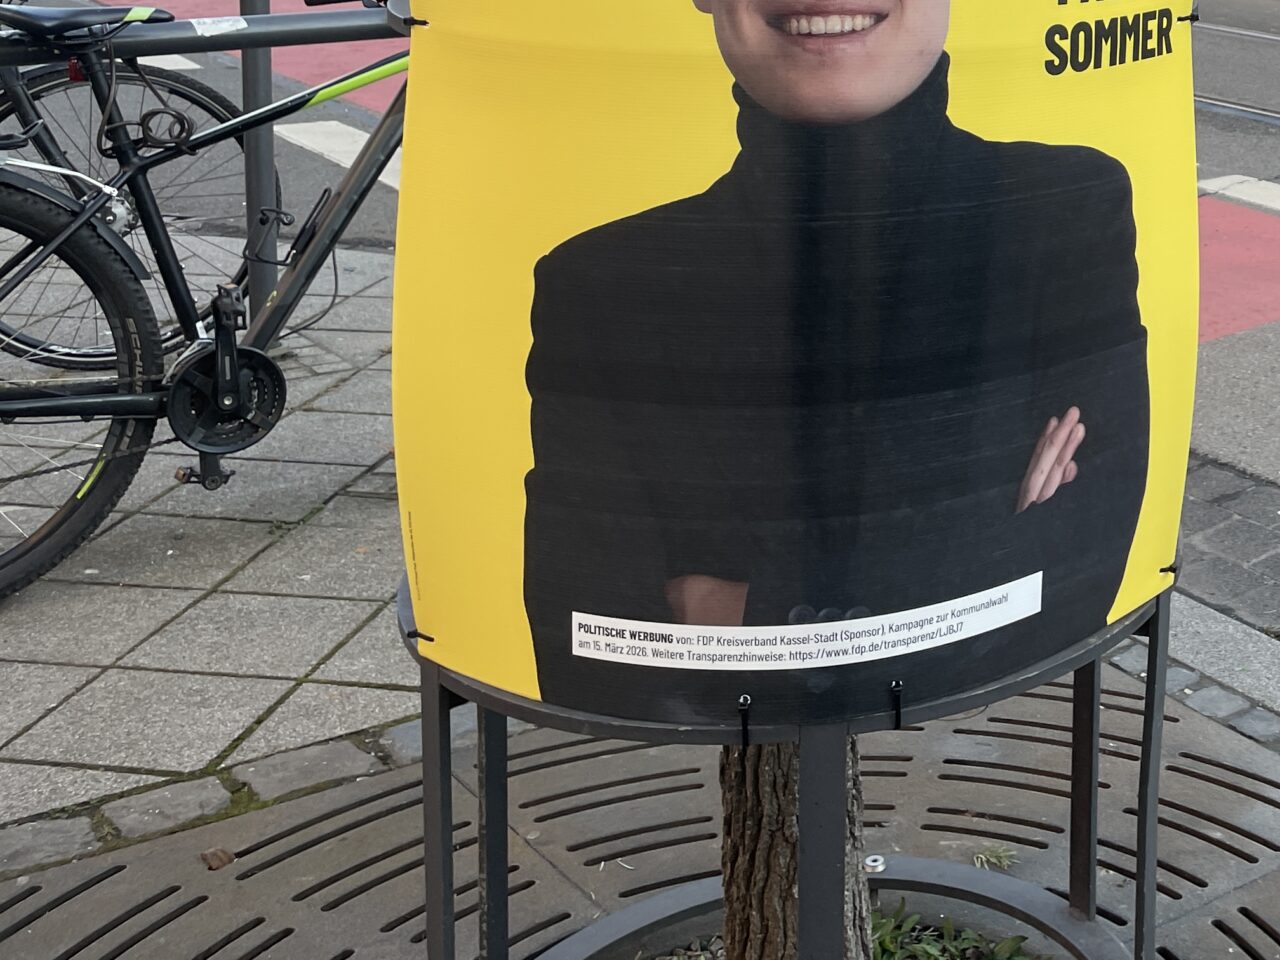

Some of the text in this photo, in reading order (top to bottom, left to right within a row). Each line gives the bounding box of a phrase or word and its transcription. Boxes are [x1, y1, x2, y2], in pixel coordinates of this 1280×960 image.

[1045, 8, 1172, 75] SOMMER
[578, 623, 627, 639] POLITISCHE
[629, 629, 673, 644] WERBUNG
[676, 635, 694, 645] von:
[697, 635, 714, 646] FDP
[716, 635, 777, 646] Kreisverband
[780, 632, 838, 645] Kassel-Stadt
[888, 616, 934, 634] Kampagne
[935, 612, 949, 623] zur
[950, 592, 1009, 620] Kommunalwahl
[578, 622, 964, 663] am 15. März 2026. Weitere Transparenzhinweise: https://www.fdp.de/transparenz/LJBJ7
